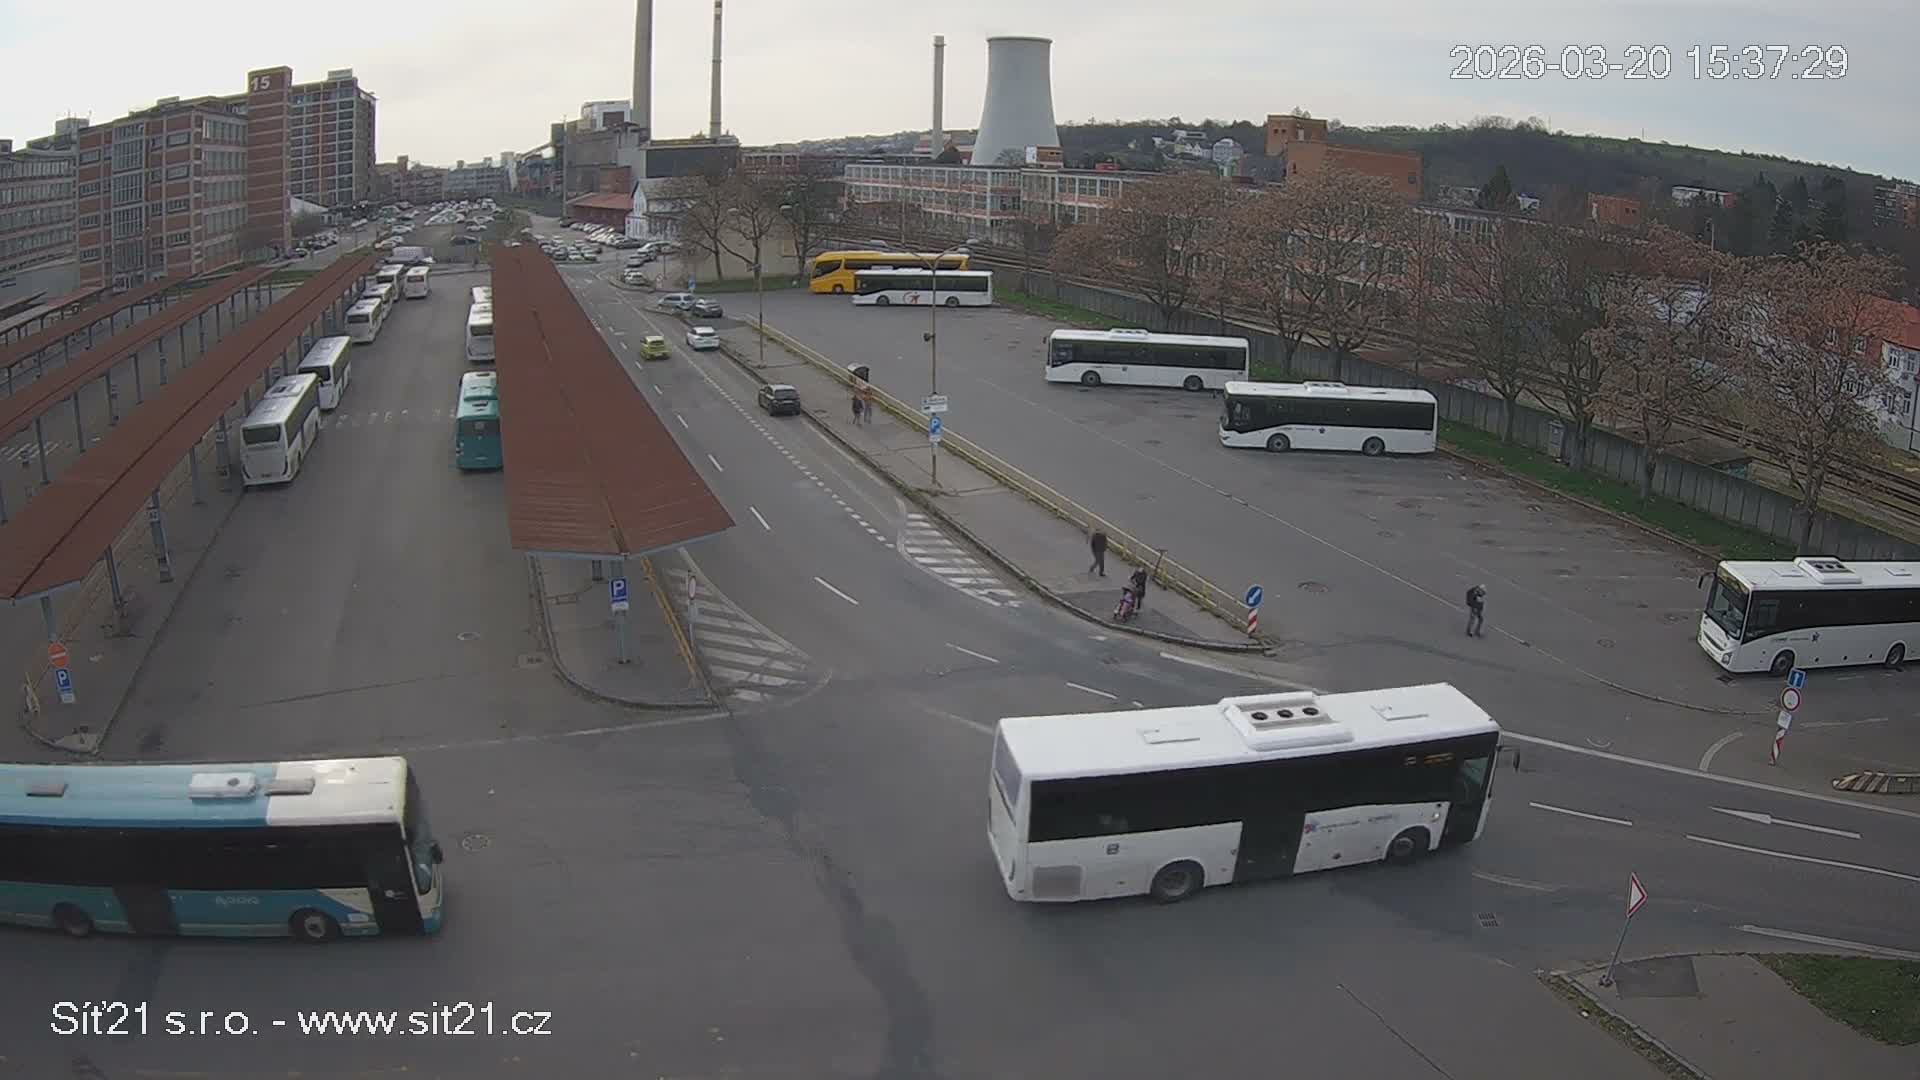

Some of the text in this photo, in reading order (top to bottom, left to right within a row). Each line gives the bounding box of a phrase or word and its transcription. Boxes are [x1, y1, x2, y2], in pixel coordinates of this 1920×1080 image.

[250, 75, 271, 91] 15
[612, 580, 625, 597] P
[57, 670, 68, 686] P
